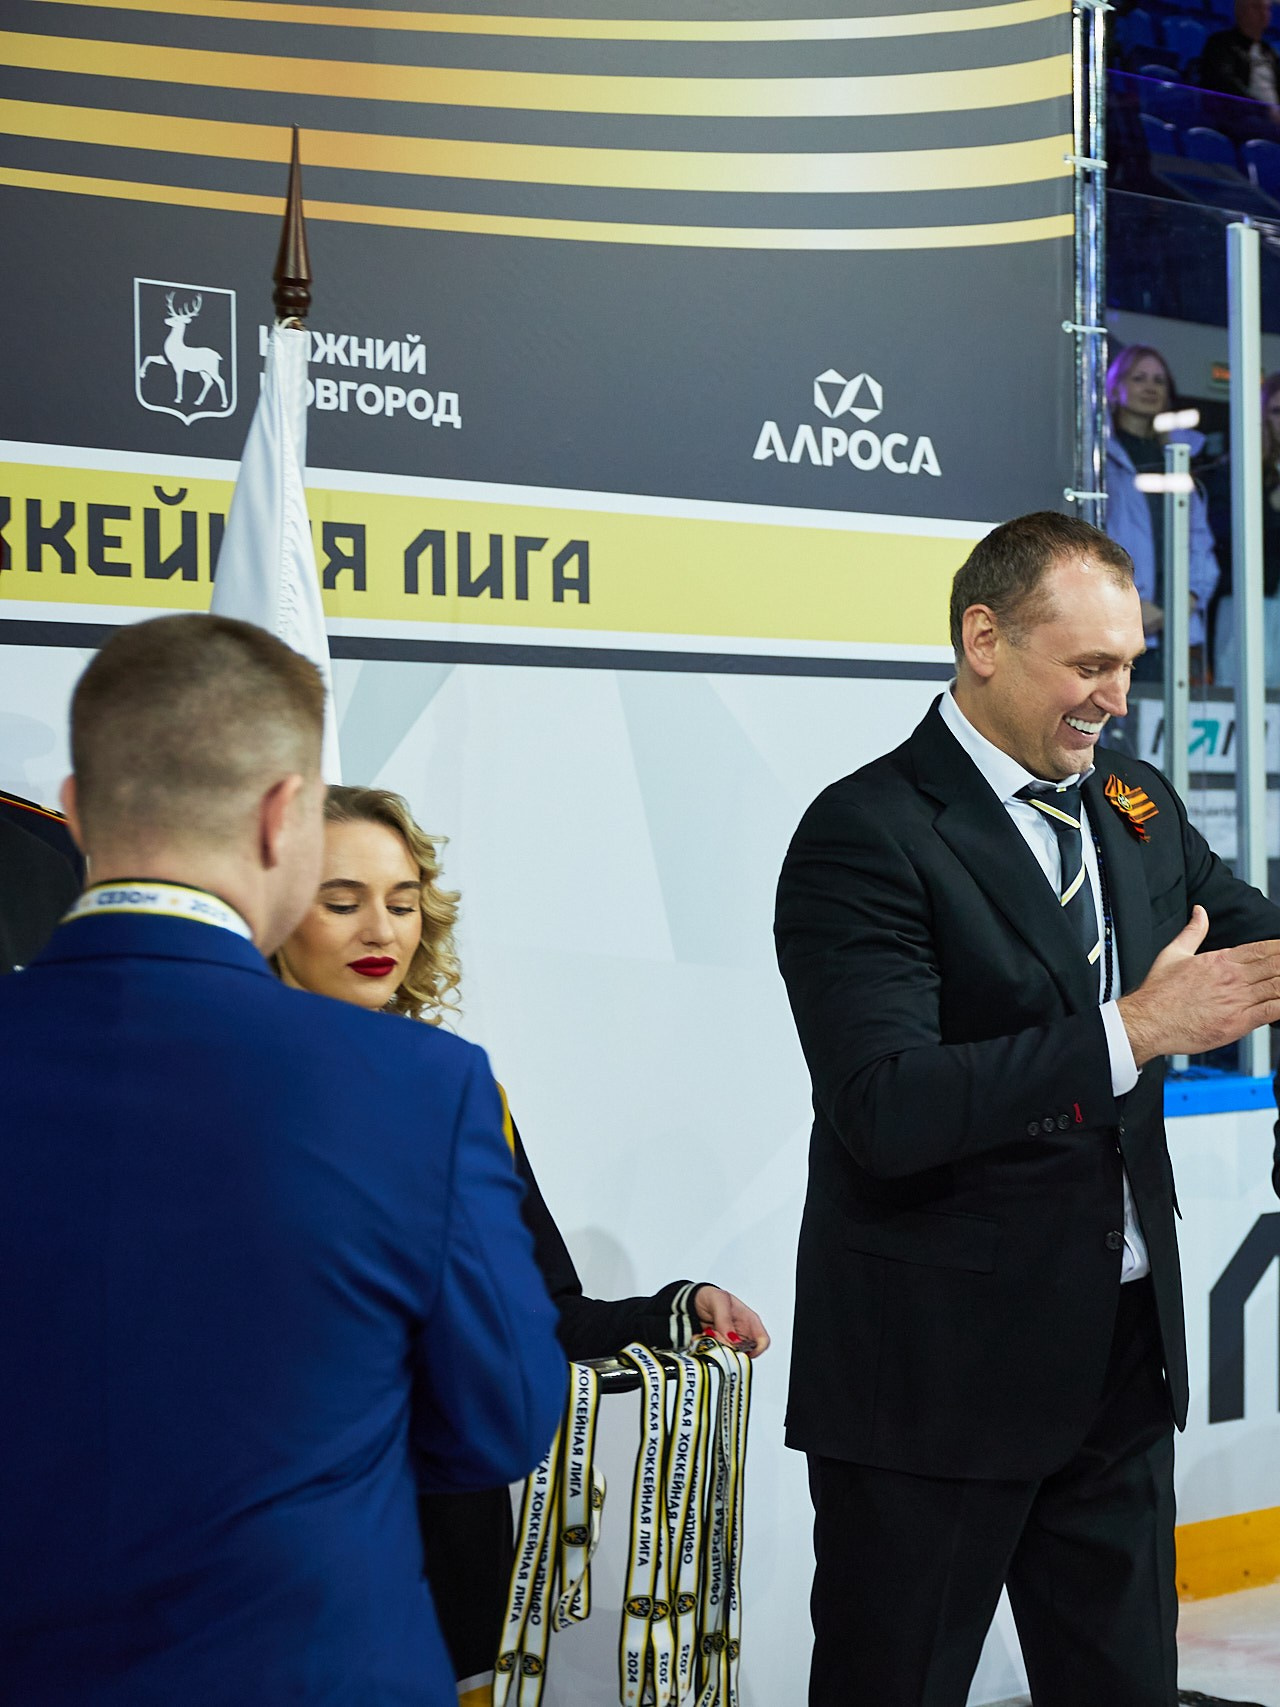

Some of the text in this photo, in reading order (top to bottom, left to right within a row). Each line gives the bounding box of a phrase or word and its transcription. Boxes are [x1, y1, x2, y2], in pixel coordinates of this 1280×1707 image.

[259, 325, 426, 375] ЖНИЙ
[259, 372, 462, 429] ВГОРОД
[752, 420, 943, 477] АЛРОСА
[0, 485, 590, 605] КЕЙЯ ЛИГА
[569, 1367, 590, 1498] ХОККЕЙНАЯ ЛИГА
[631, 1347, 660, 1567] ОФИЦЕРСКАЯ ХОККЕЙНАЯ ЛИГА
[667, 1353, 697, 1520] ЦЕРСКАЯ ХОККЕЙНАЯ
[518, 1491, 546, 1580] ХОККЕЙНАЯ
[710, 1508, 724, 1606] ОФИЦЕРСКАЯ
[510, 1585, 527, 1623] ЛИГА
[627, 1651, 639, 1683] 2024
[659, 1652, 669, 1685] 2025
[680, 1644, 690, 1676] 2025
